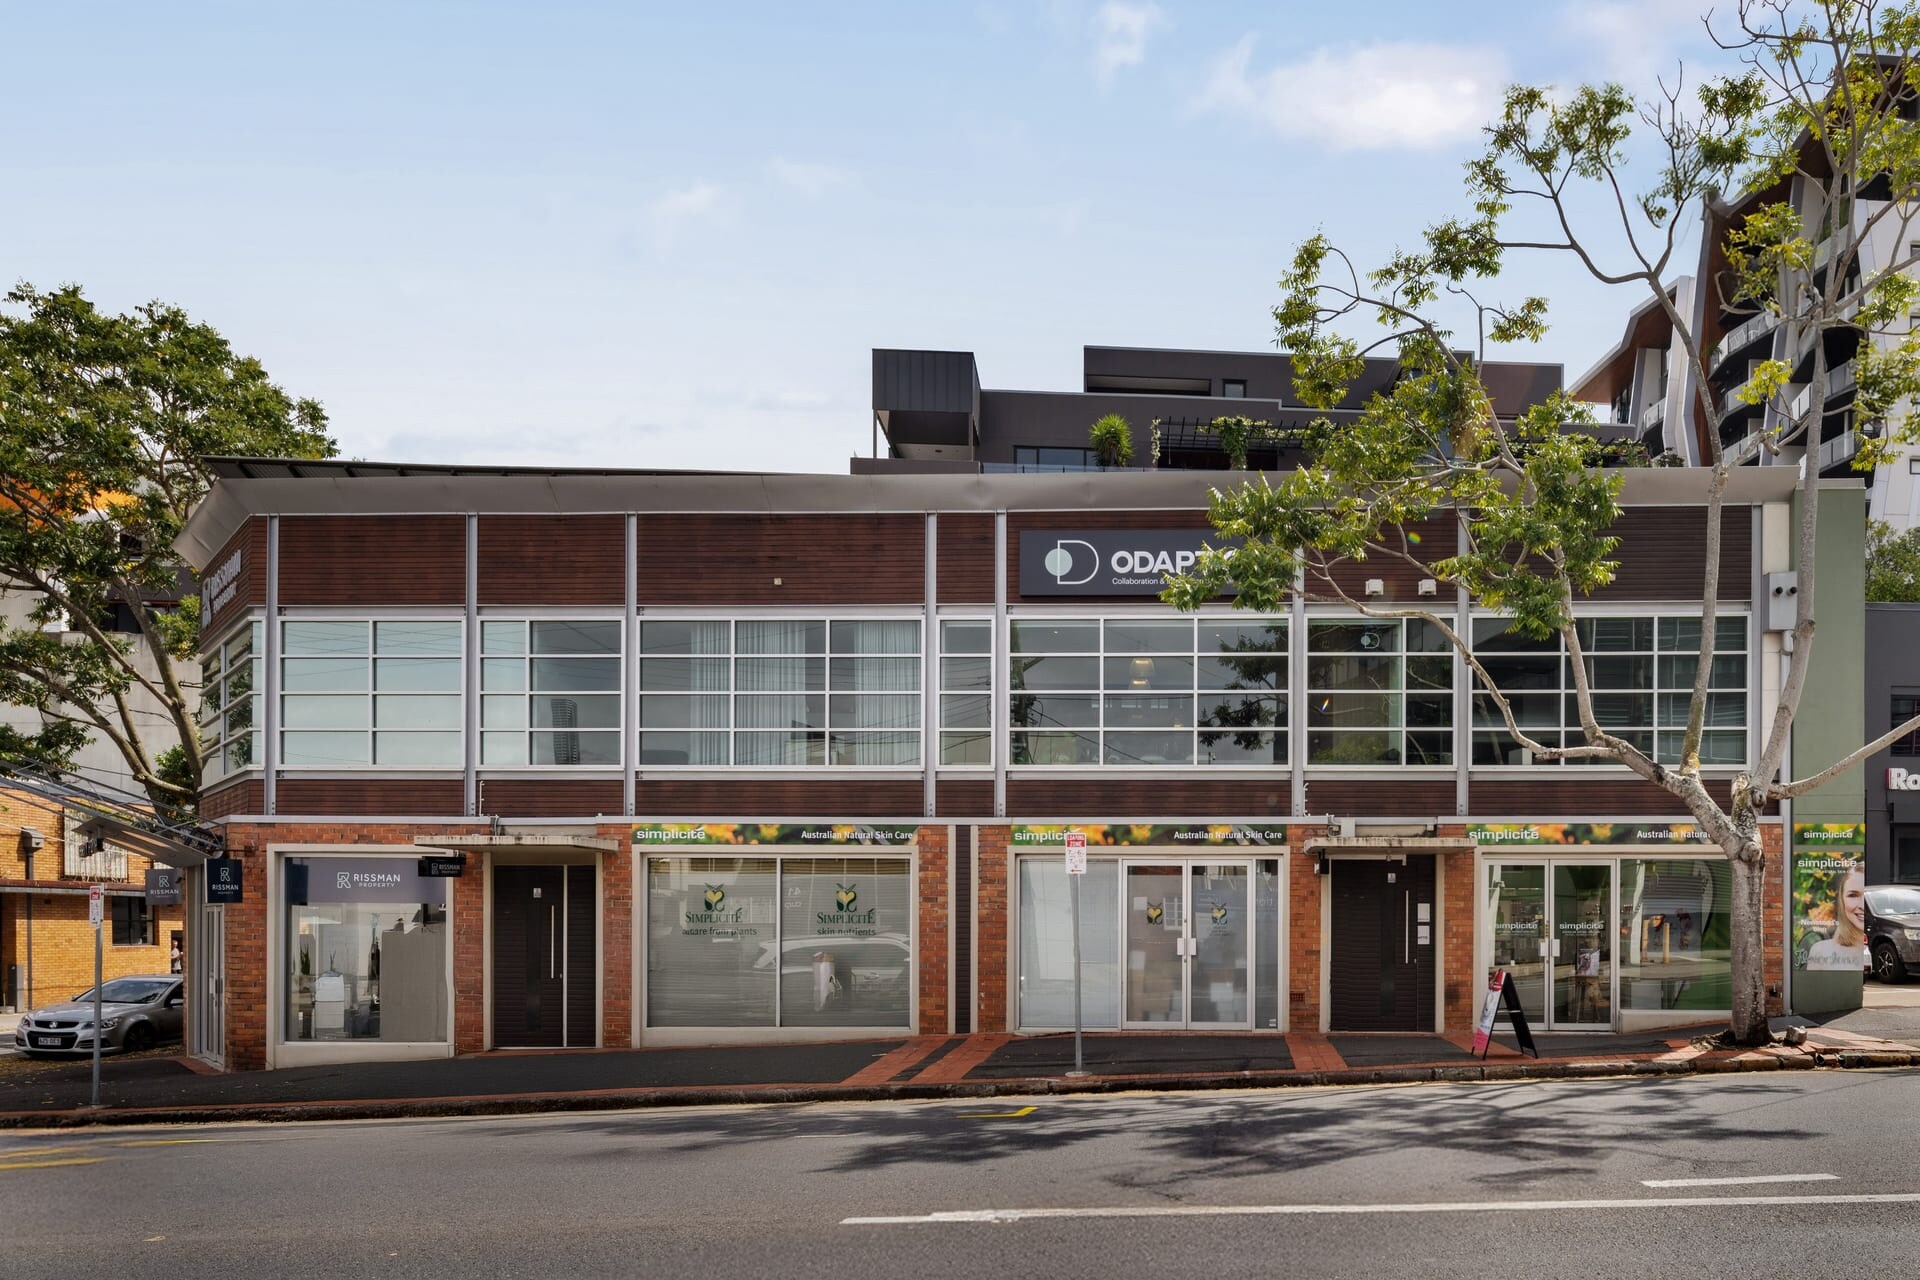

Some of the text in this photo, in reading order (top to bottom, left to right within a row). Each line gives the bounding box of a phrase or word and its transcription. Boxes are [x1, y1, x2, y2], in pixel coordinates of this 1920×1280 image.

[636, 826, 705, 841] simplicité
[801, 831, 913, 839] Australian Natural Skin Care
[1014, 828, 1081, 843] simplici
[1173, 831, 1283, 839] Australian Natural Skin Care
[1469, 826, 1540, 842] simplicité
[1636, 830, 1679, 838] Australian
[1803, 828, 1853, 840] simplicité
[1798, 855, 1858, 869] simplicité
[353, 874, 400, 882] RISSMAN
[816, 927, 876, 936] skin nutrients
